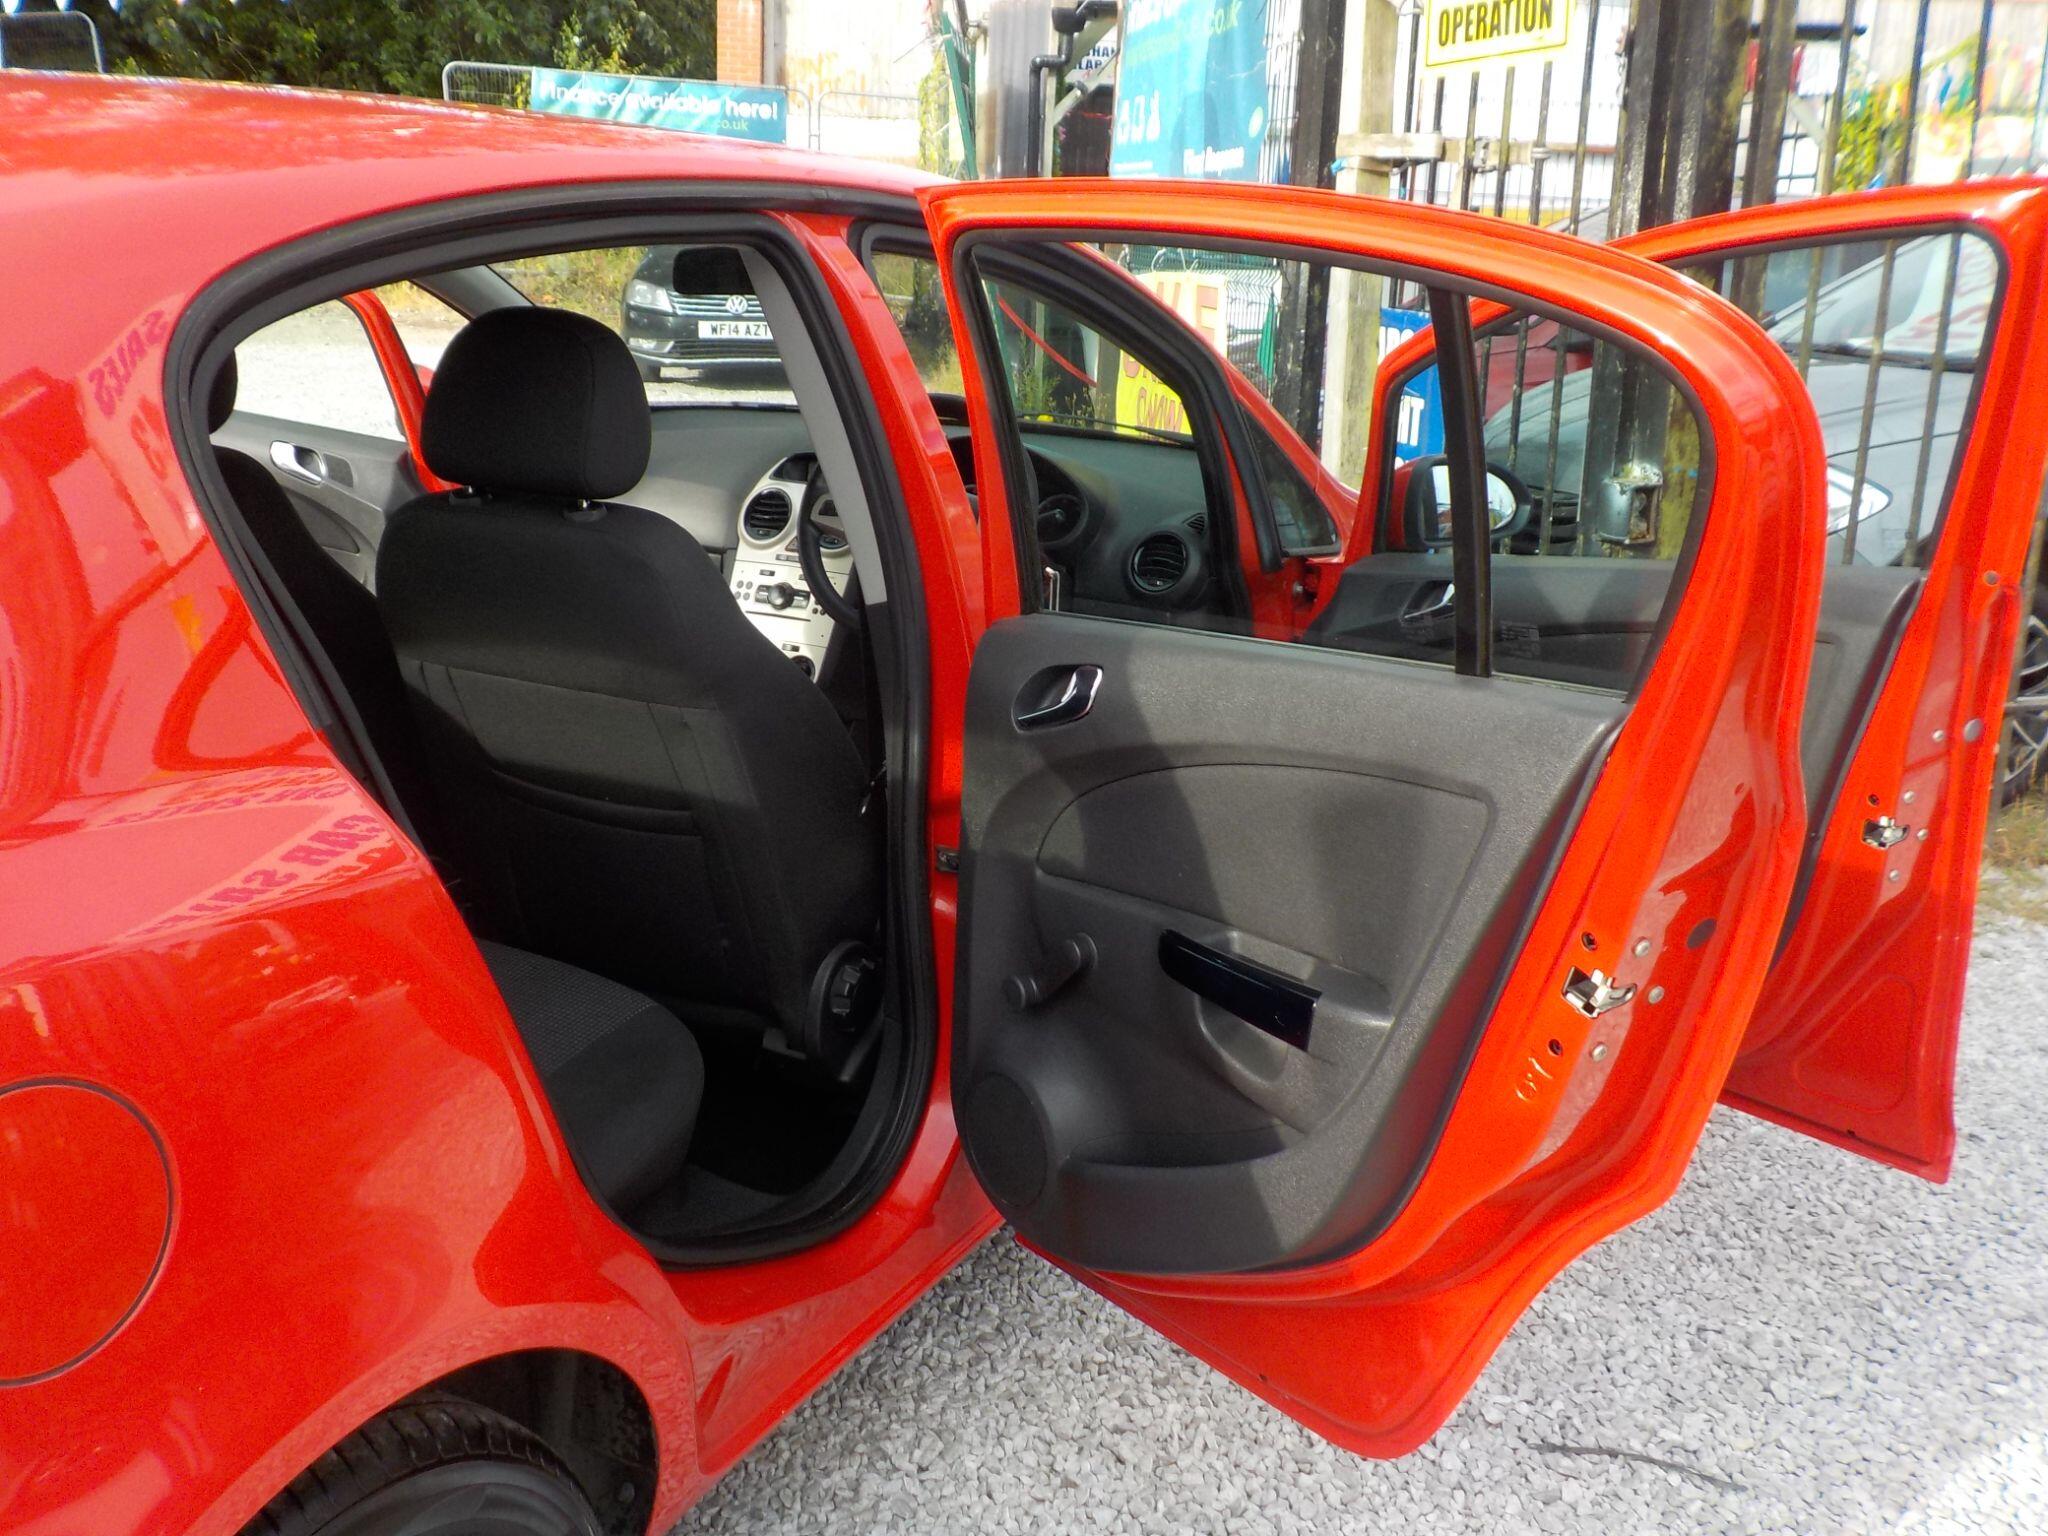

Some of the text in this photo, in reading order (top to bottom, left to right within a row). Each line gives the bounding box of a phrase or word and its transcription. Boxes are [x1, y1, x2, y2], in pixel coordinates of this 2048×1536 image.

[1438, 0, 1553, 46] OPERATION
[725, 96, 778, 120] here!
[711, 323, 740, 336] WF14
